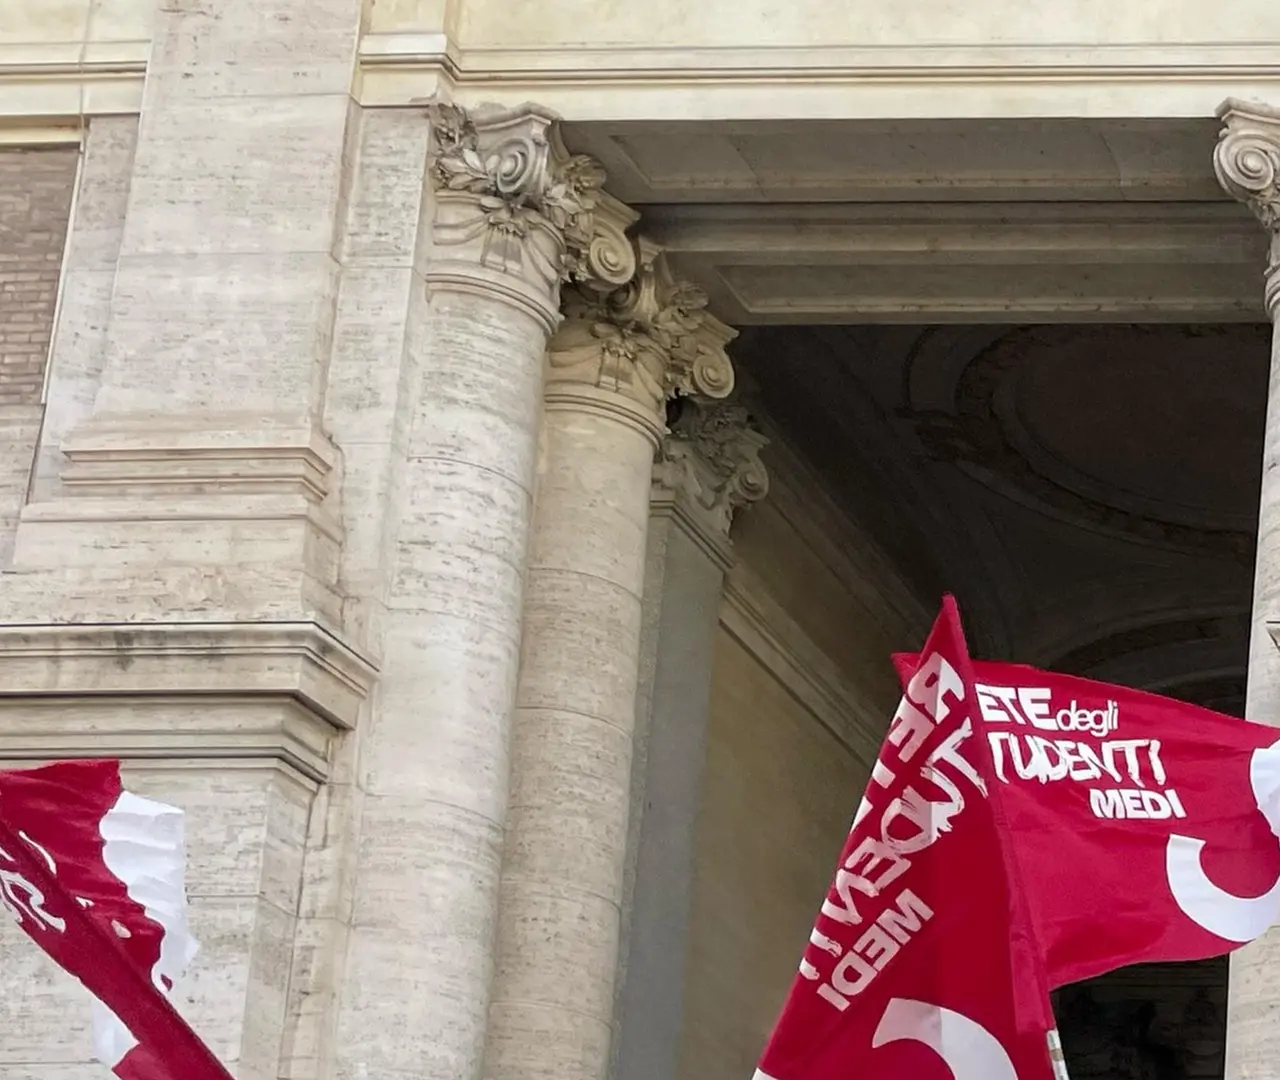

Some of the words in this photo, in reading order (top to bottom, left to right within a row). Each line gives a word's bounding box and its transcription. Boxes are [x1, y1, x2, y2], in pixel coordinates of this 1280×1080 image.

[975, 683, 1058, 730] ETE
[1056, 699, 1119, 737] degli
[987, 731, 1166, 788] TUDENTI
[1089, 788, 1187, 819] MEDI
